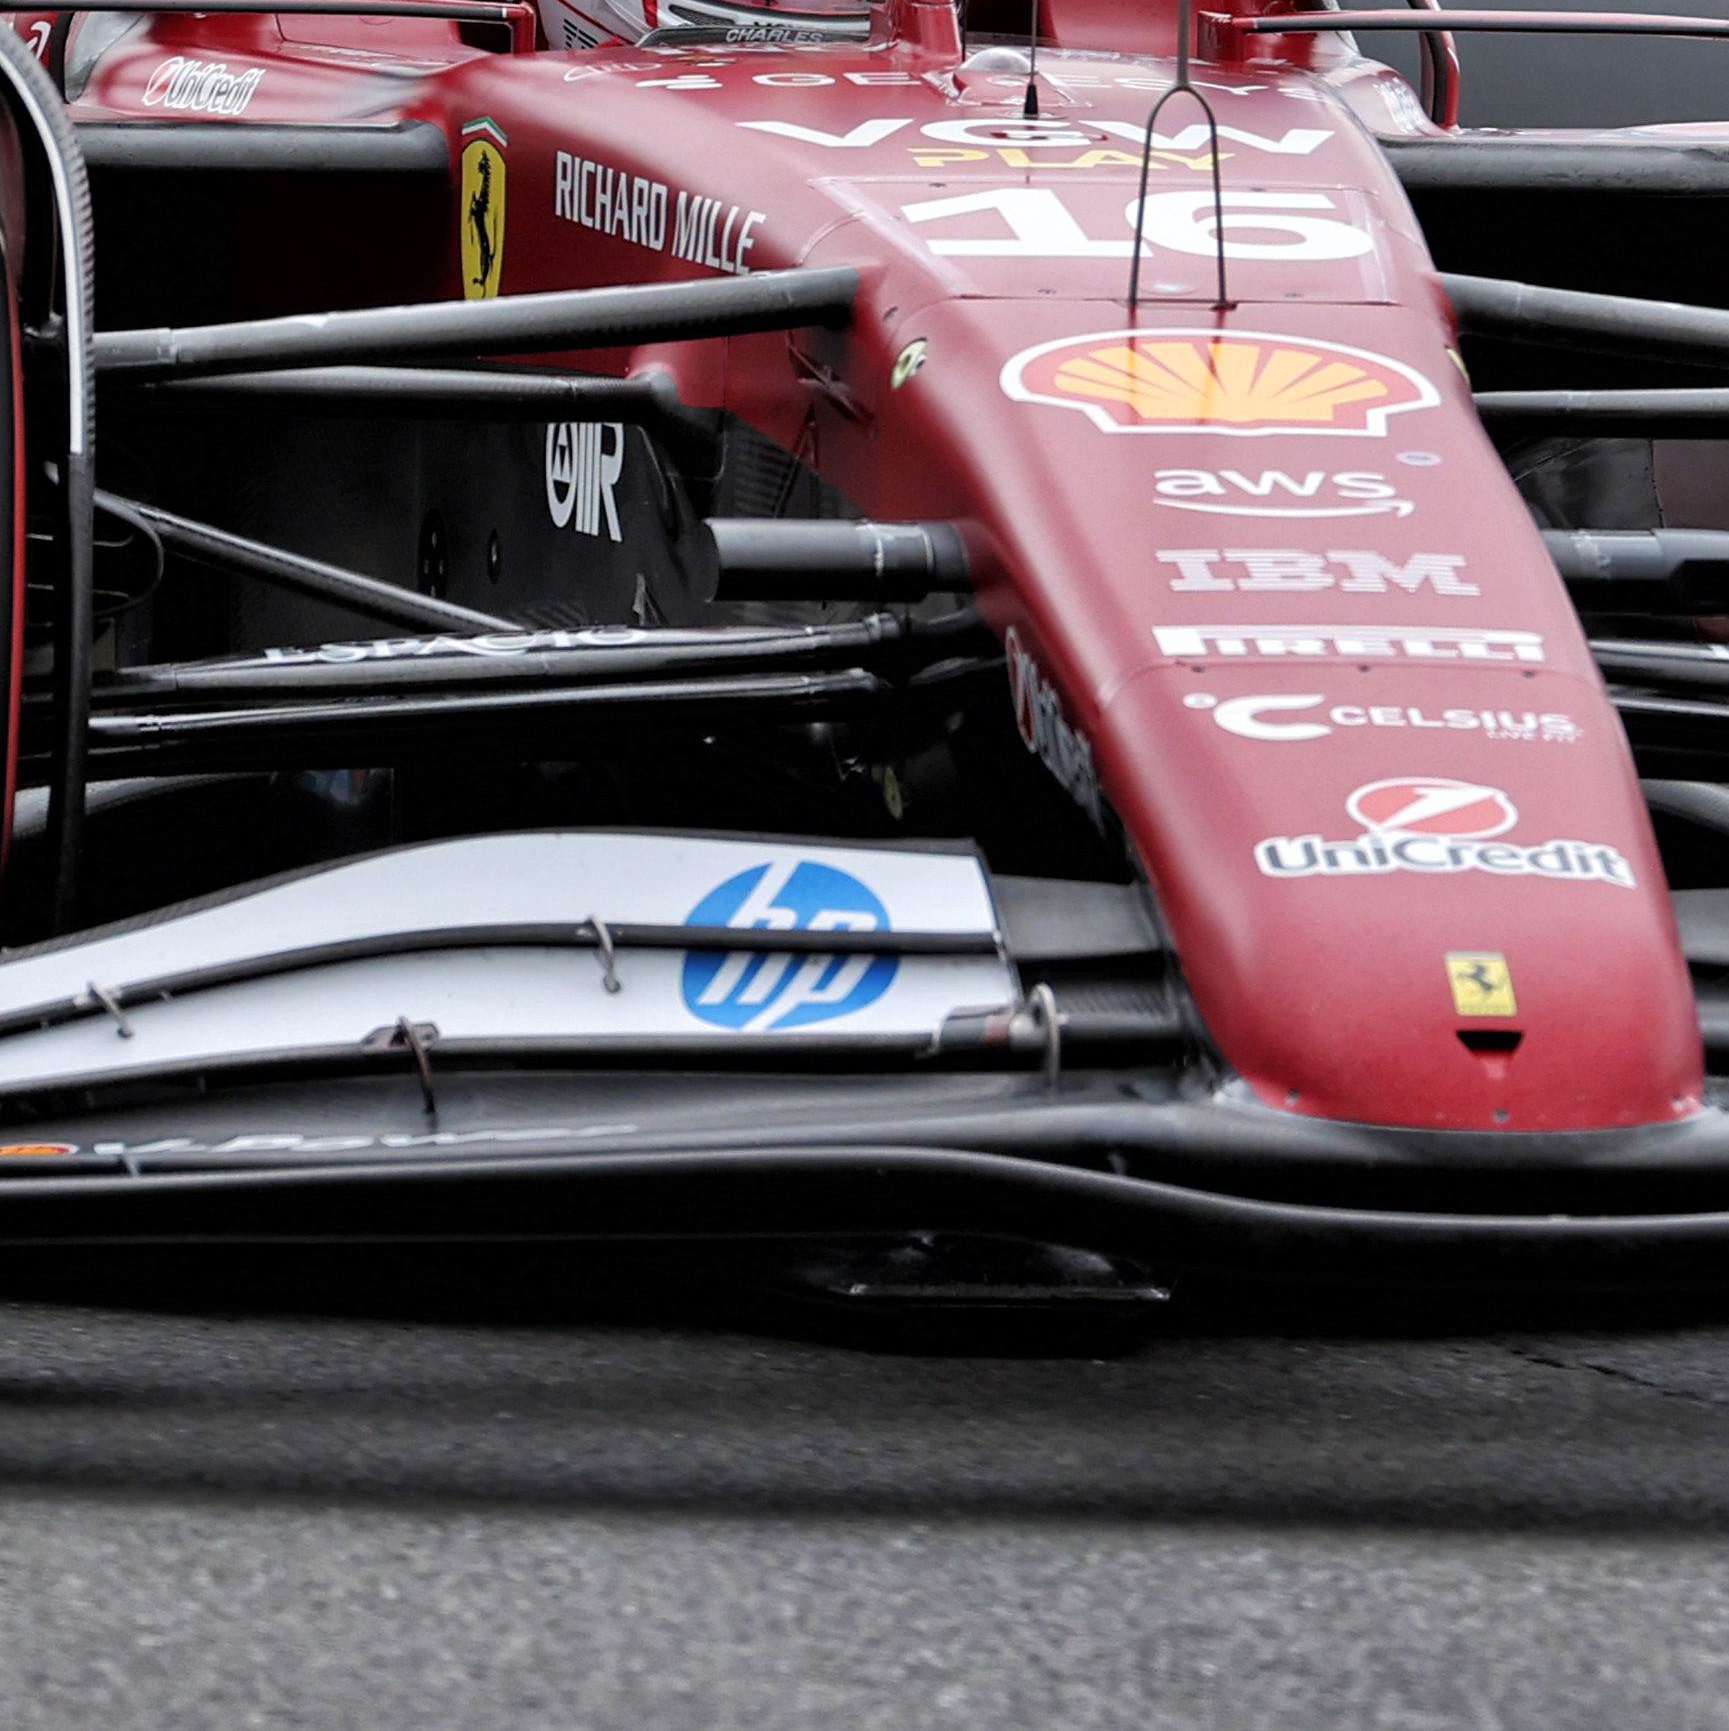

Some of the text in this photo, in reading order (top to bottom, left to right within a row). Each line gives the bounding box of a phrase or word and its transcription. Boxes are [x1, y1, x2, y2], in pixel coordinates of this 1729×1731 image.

[725, 27, 823, 45] CHARLES
[736, 118, 1334, 155] VGW
[908, 146, 1236, 170] PLAY
[554, 150, 768, 274] RICHARD MILLE
[901, 187, 1375, 261] 16
[1155, 548, 1481, 597] IBM
[1151, 625, 1546, 662] PIRELLI
[1329, 705, 1575, 734] CELSIUS
[1258, 835, 1633, 885] UniCredit
[697, 860, 892, 1031] hp
